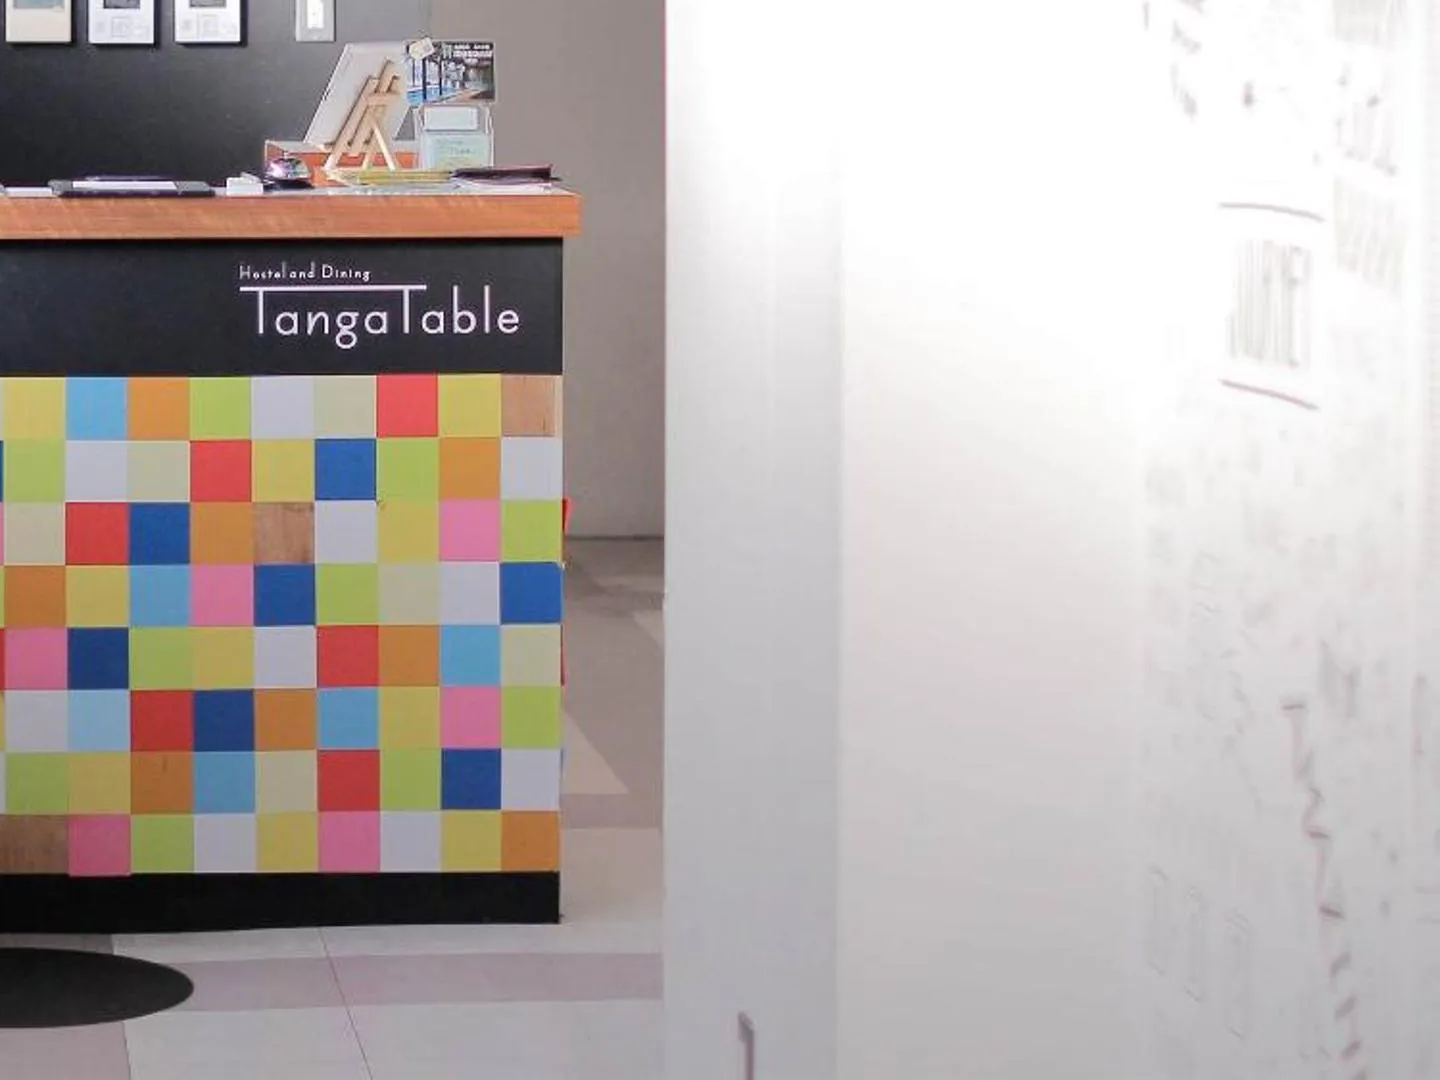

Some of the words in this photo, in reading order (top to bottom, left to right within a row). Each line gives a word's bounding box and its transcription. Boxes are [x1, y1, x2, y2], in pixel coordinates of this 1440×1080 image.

[239, 261, 286, 280] Hostel
[289, 261, 316, 279] and
[321, 263, 371, 282] Dining
